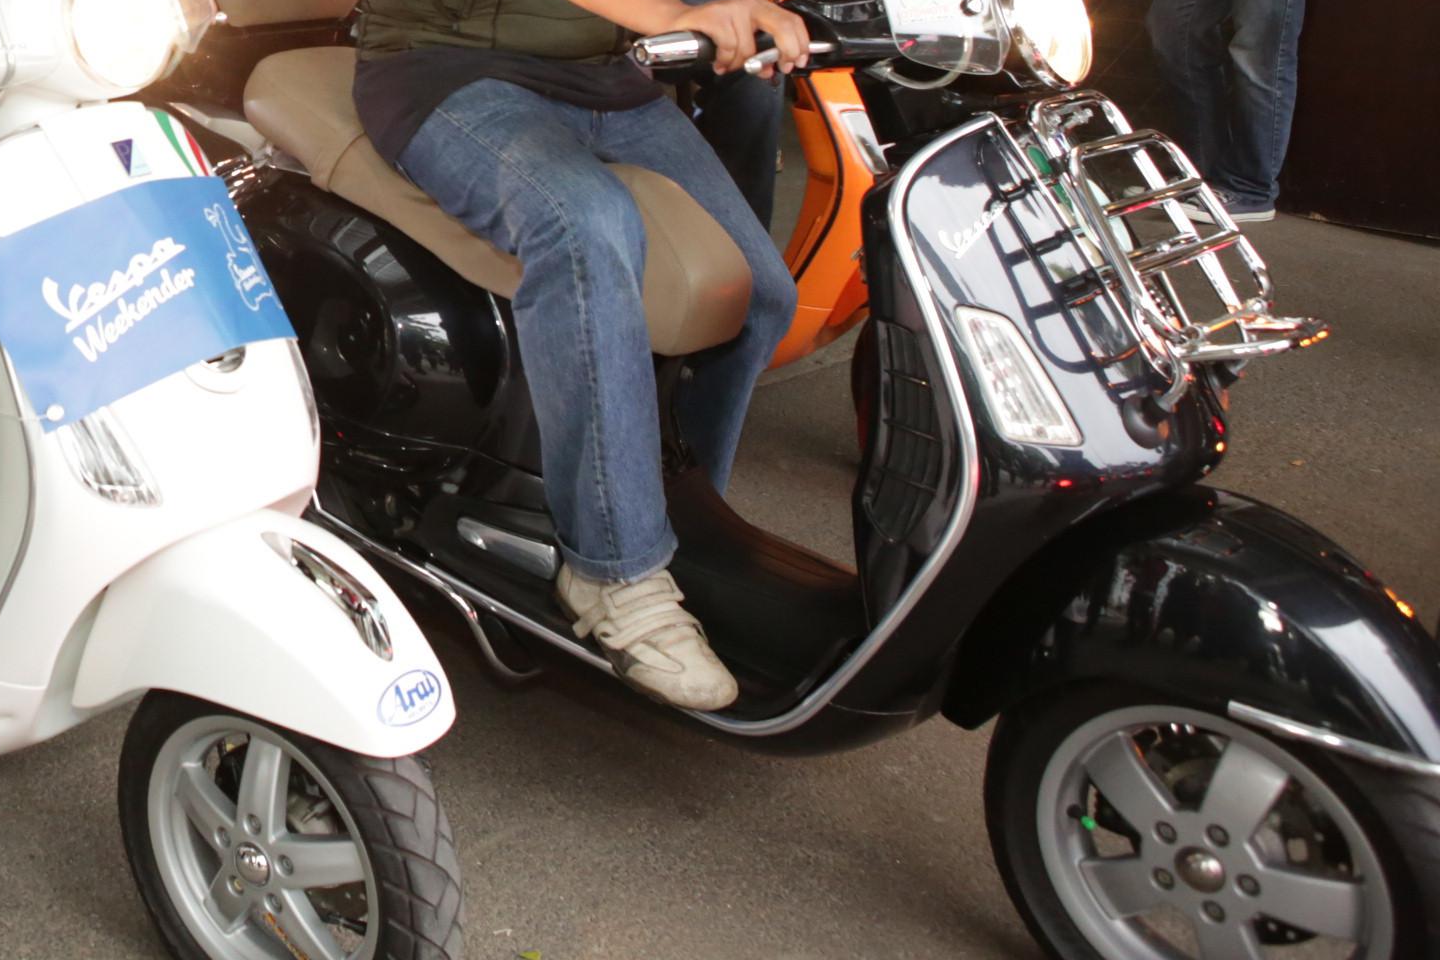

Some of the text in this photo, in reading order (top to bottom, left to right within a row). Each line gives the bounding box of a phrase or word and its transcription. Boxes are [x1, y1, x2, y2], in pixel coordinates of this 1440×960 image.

[938, 201, 1008, 260] Vespa
[42, 237, 187, 332] Vespa
[72, 267, 197, 363] Weekender
